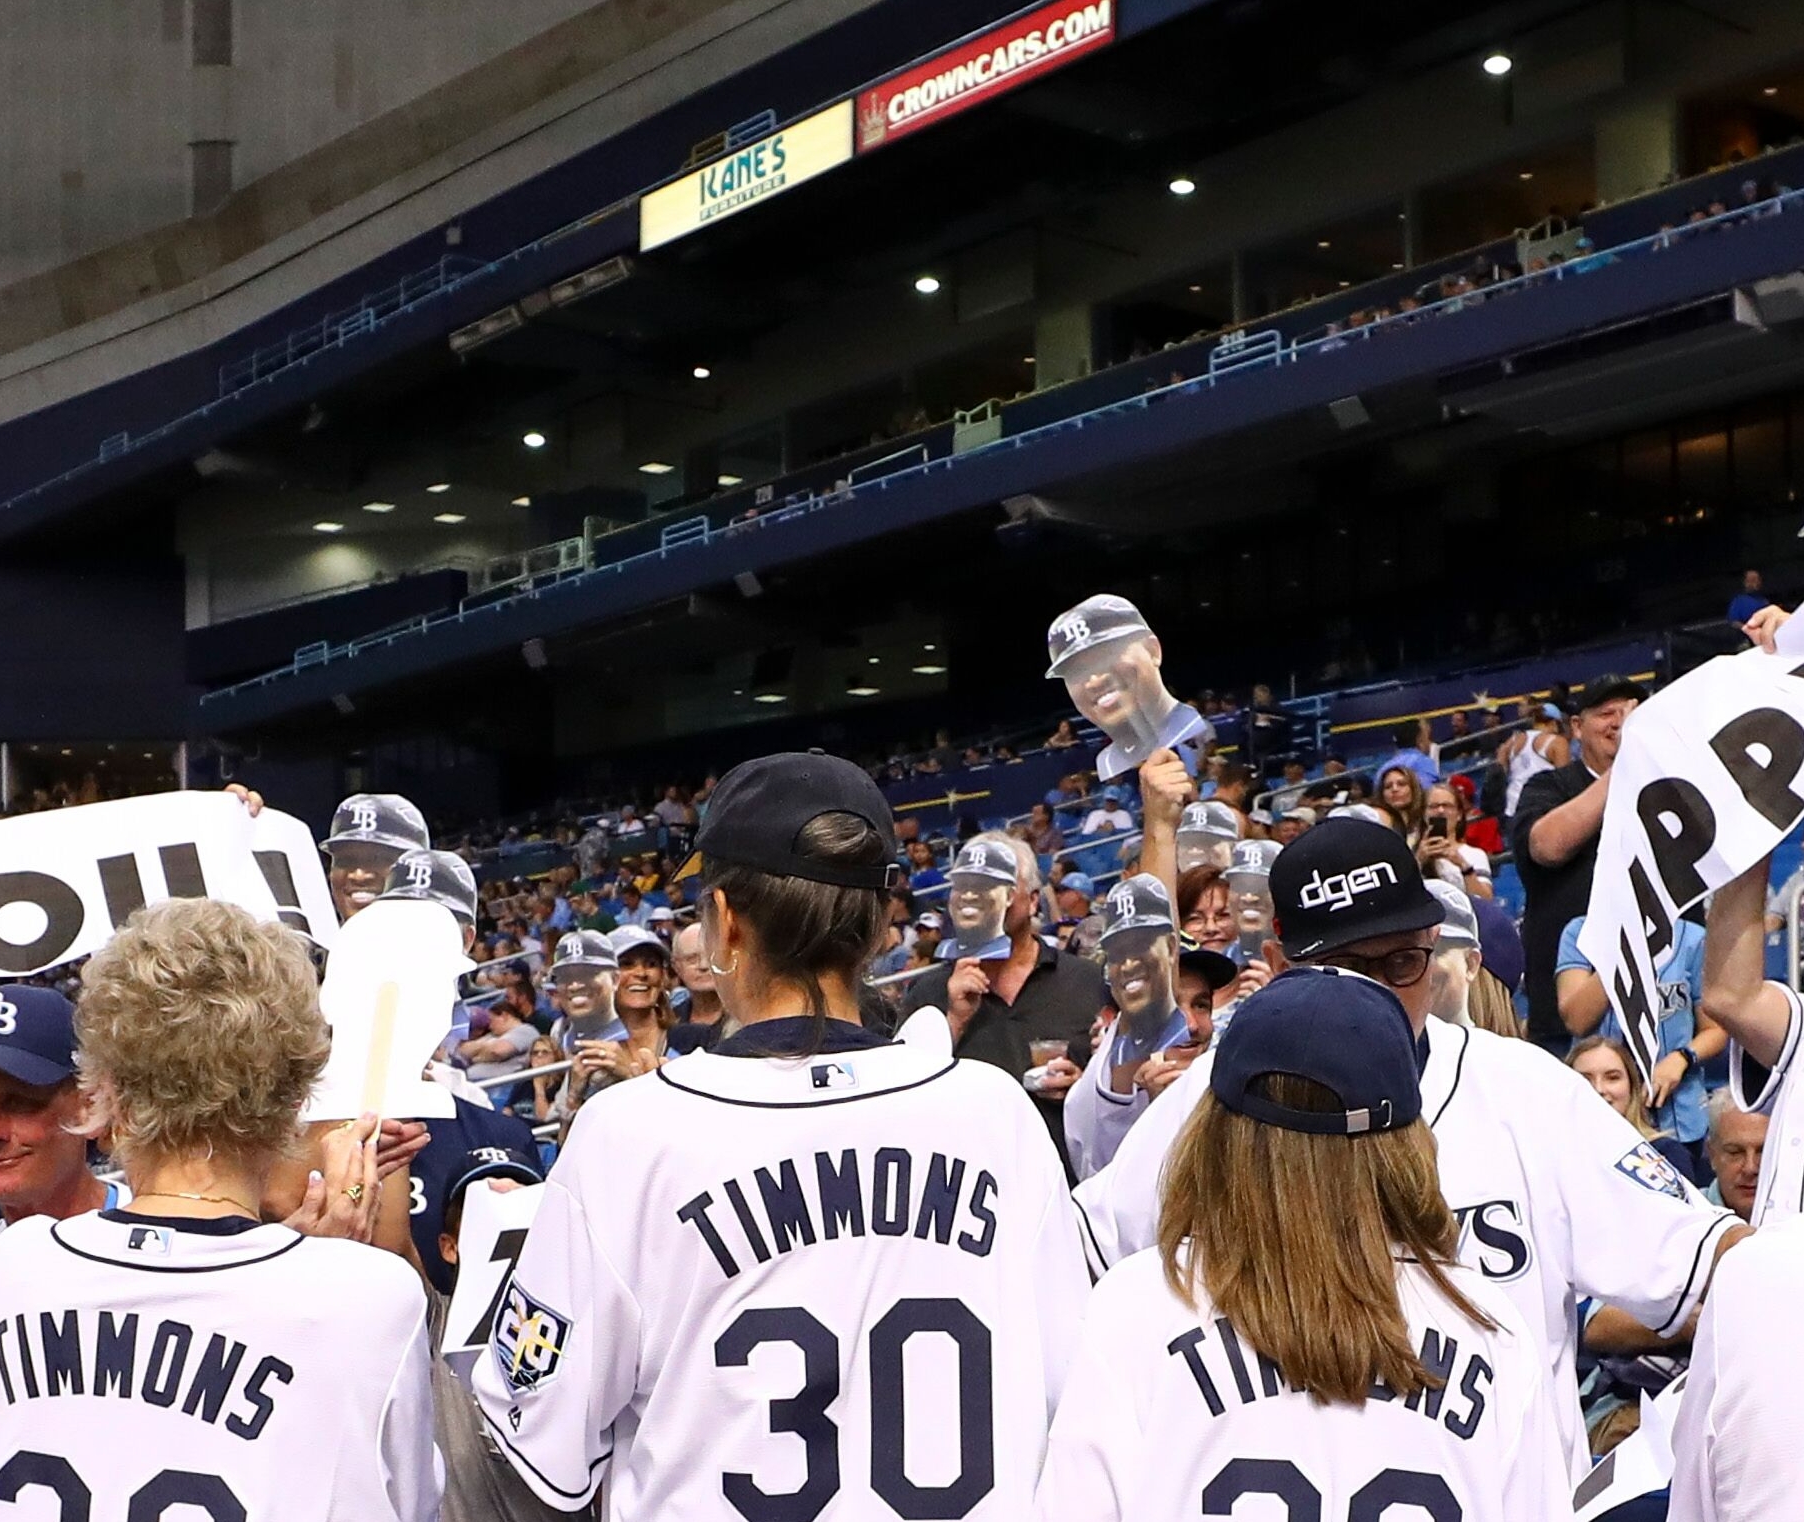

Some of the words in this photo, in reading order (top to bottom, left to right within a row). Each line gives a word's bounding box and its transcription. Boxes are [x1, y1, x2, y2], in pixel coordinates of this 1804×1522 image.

[887, 0, 1112, 123] CROWNCARS.COM
[700, 135, 786, 205] KANE'S
[1299, 862, 1399, 912] dgen
[677, 1147, 999, 1278] TIMMONS
